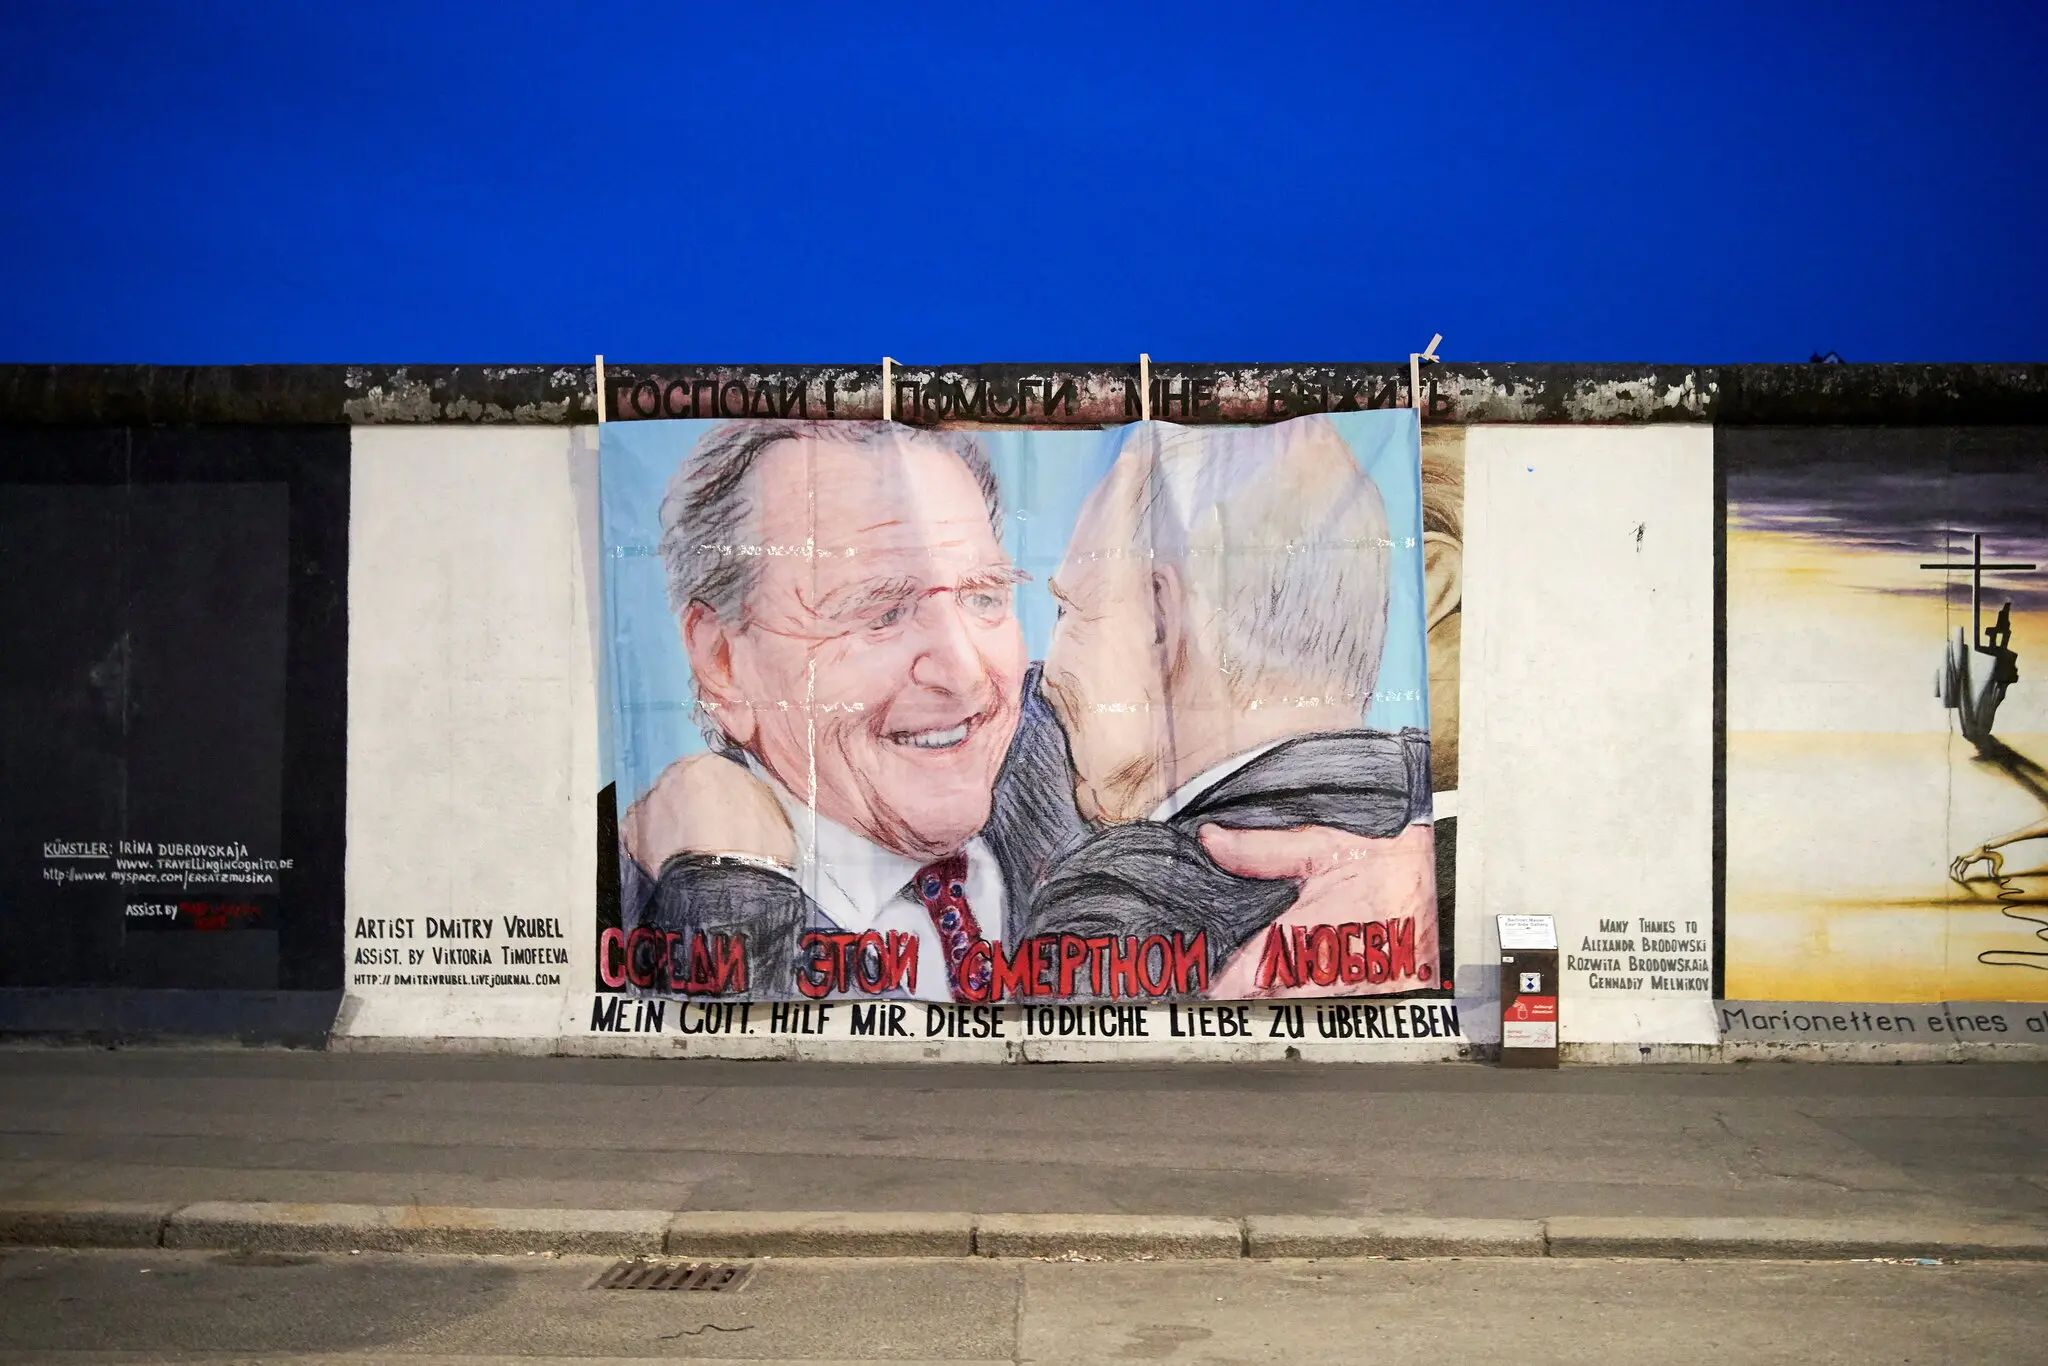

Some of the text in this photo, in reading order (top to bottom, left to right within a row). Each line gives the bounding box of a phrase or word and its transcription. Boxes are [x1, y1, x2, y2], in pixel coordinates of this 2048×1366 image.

[43, 838, 113, 858] KÜNSTLER:
[503, 915, 564, 939] VRUBEL
[1599, 918, 1629, 933] MANY
[679, 1001, 755, 1035] GOTT.
[1268, 1005, 1305, 1038] ZU
[1722, 1008, 1919, 1033] Marionetten
[1929, 1011, 2008, 1033] eines
